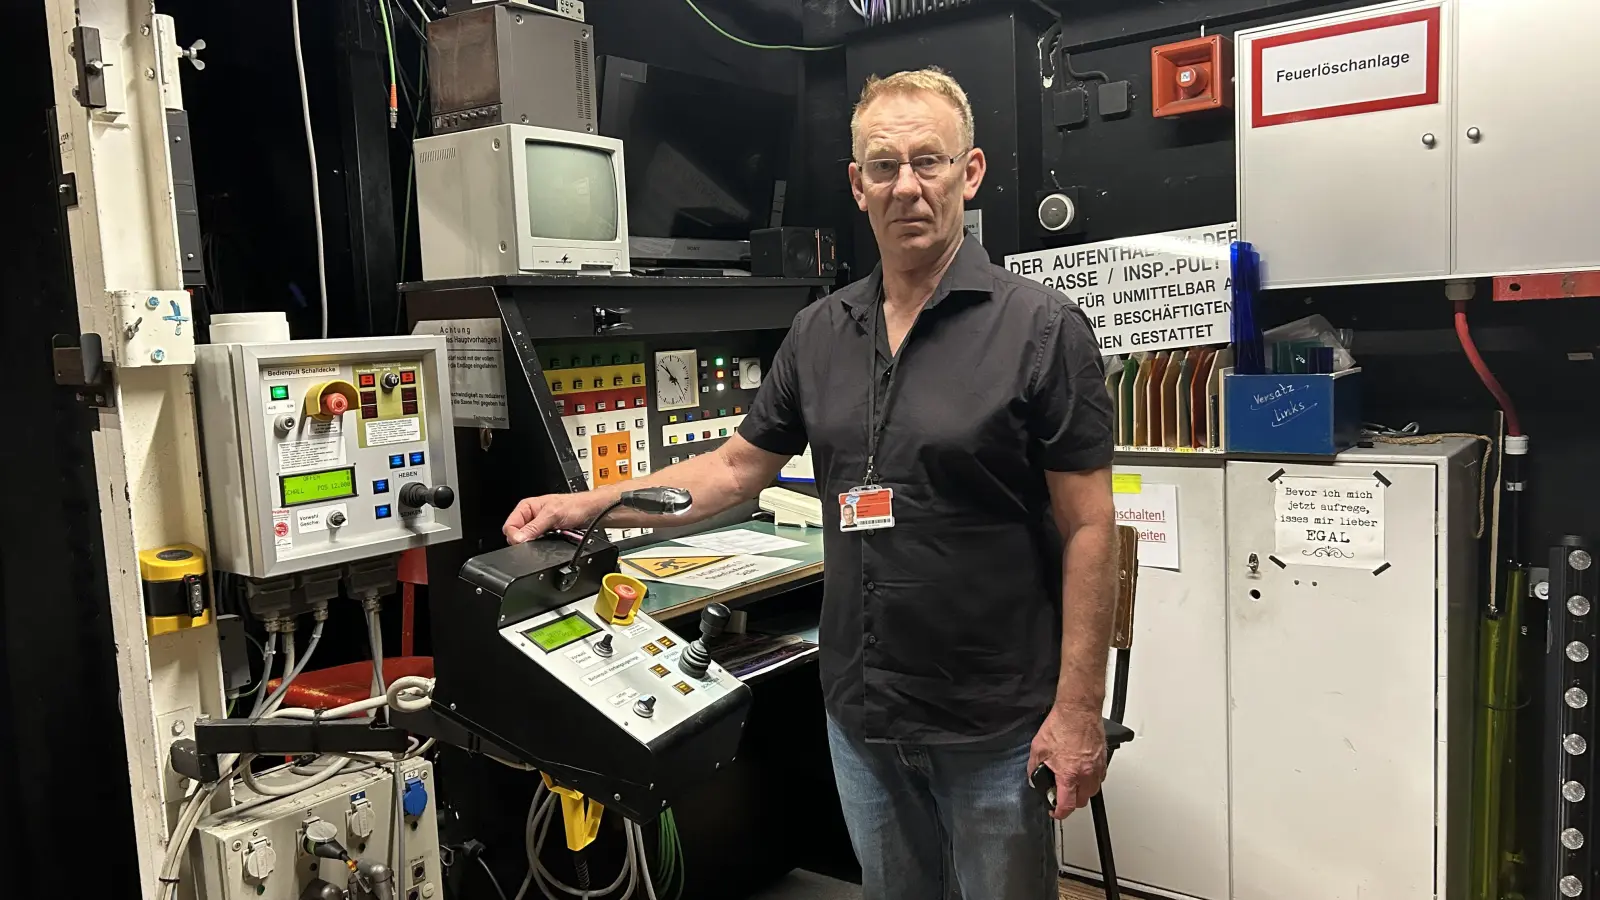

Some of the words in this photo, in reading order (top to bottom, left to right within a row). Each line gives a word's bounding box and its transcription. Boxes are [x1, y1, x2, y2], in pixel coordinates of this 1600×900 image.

[1276, 52, 1410, 83] Feuerlöschanlage
[1010, 258, 1043, 275] DER
[1053, 243, 1162, 271] AUFENTHAL
[1042, 271, 1098, 291] GASSE
[1107, 267, 1114, 285] /
[1077, 293, 1105, 308] FÜR
[1113, 279, 1216, 305] UNMITTELBAR
[440, 327, 471, 335] Achtung
[1130, 323, 1213, 345] GESTATTET
[454, 336, 497, 344] Hauptvorhanges
[1253, 383, 1295, 404] Versatz
[1273, 400, 1305, 422] Links
[1285, 487, 1317, 497] Bevor
[1323, 489, 1341, 498] ich
[1346, 490, 1373, 499] mich
[1115, 508, 1165, 521] nschalten!
[1287, 501, 1316, 511] jetzt
[1320, 503, 1370, 515] aufrege,
[1280, 515, 1309, 523] isses
[1314, 517, 1334, 525] mir
[1340, 517, 1378, 527] lieber
[1306, 529, 1350, 544] EGAL
[306, 808, 312, 817] 5
[252, 829, 258, 837] 6
